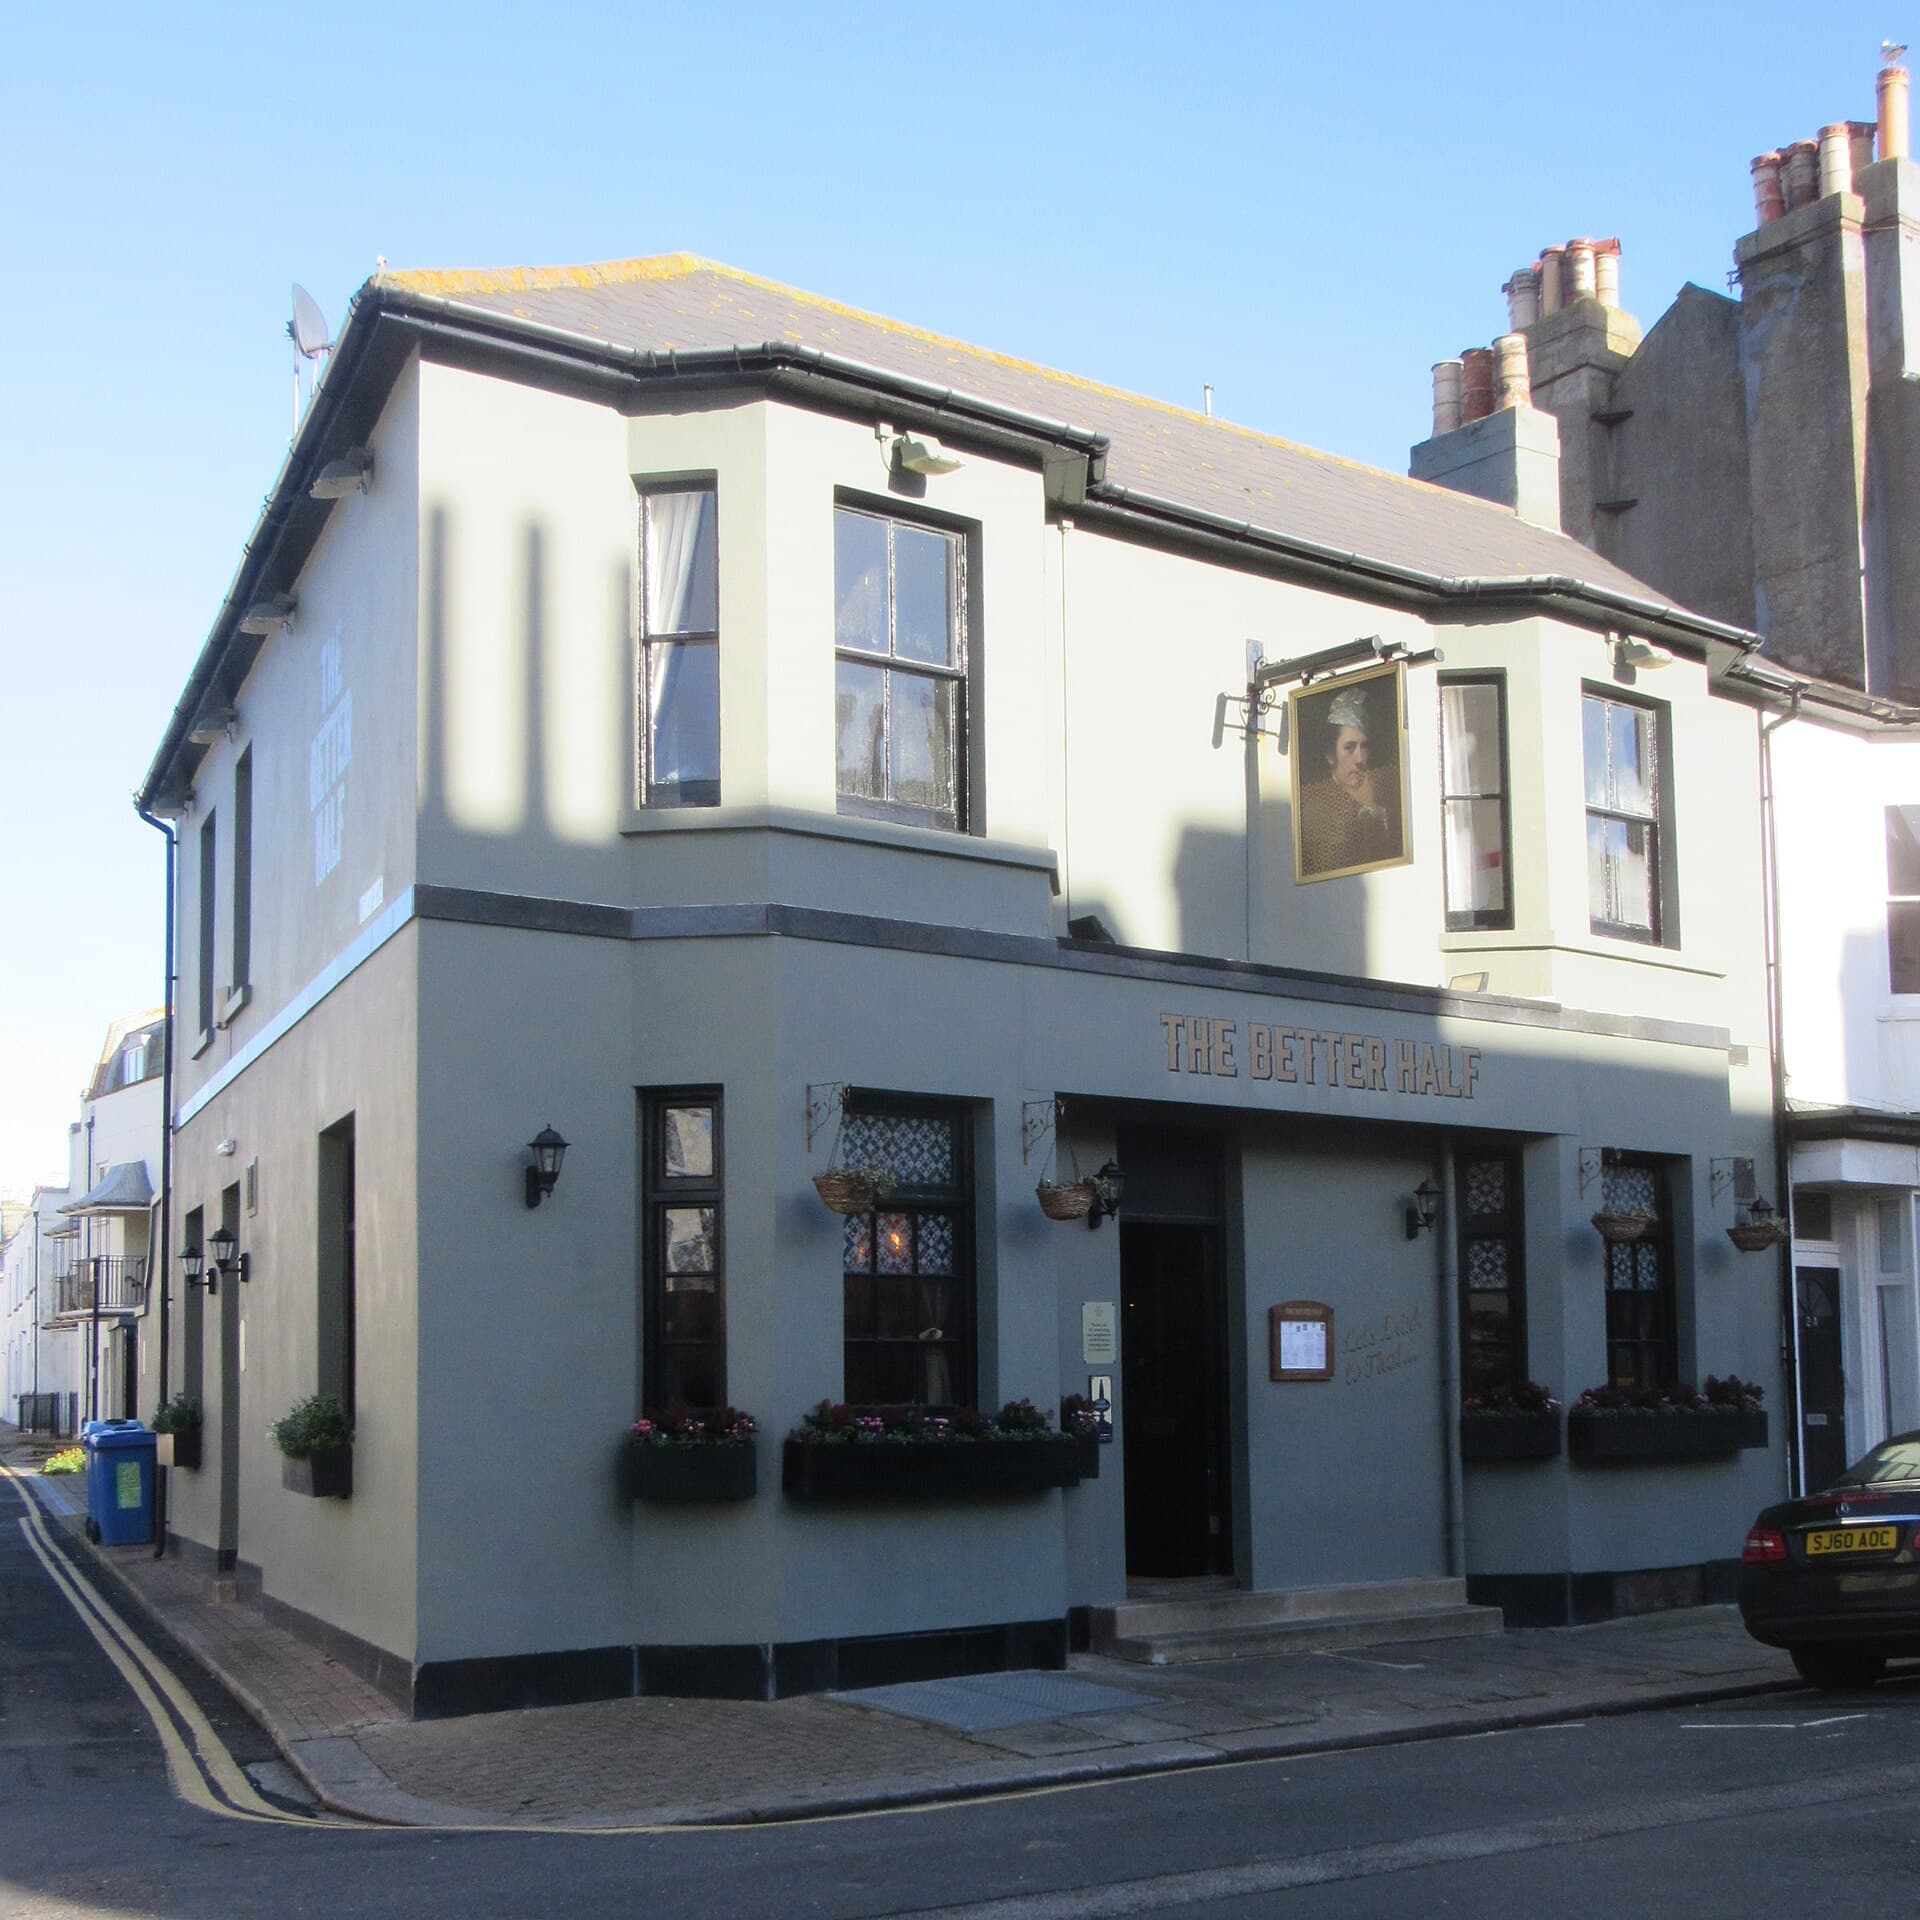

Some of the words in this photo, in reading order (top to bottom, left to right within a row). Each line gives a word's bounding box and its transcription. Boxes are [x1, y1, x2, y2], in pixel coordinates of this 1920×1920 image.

[1160, 1013, 1237, 1077] THE
[1249, 1022, 1387, 1092] BETTER
[1394, 1038, 1482, 1099] HALF
[1813, 1532, 1854, 1551] SJ60
[1858, 1530, 1890, 1548] AOC
